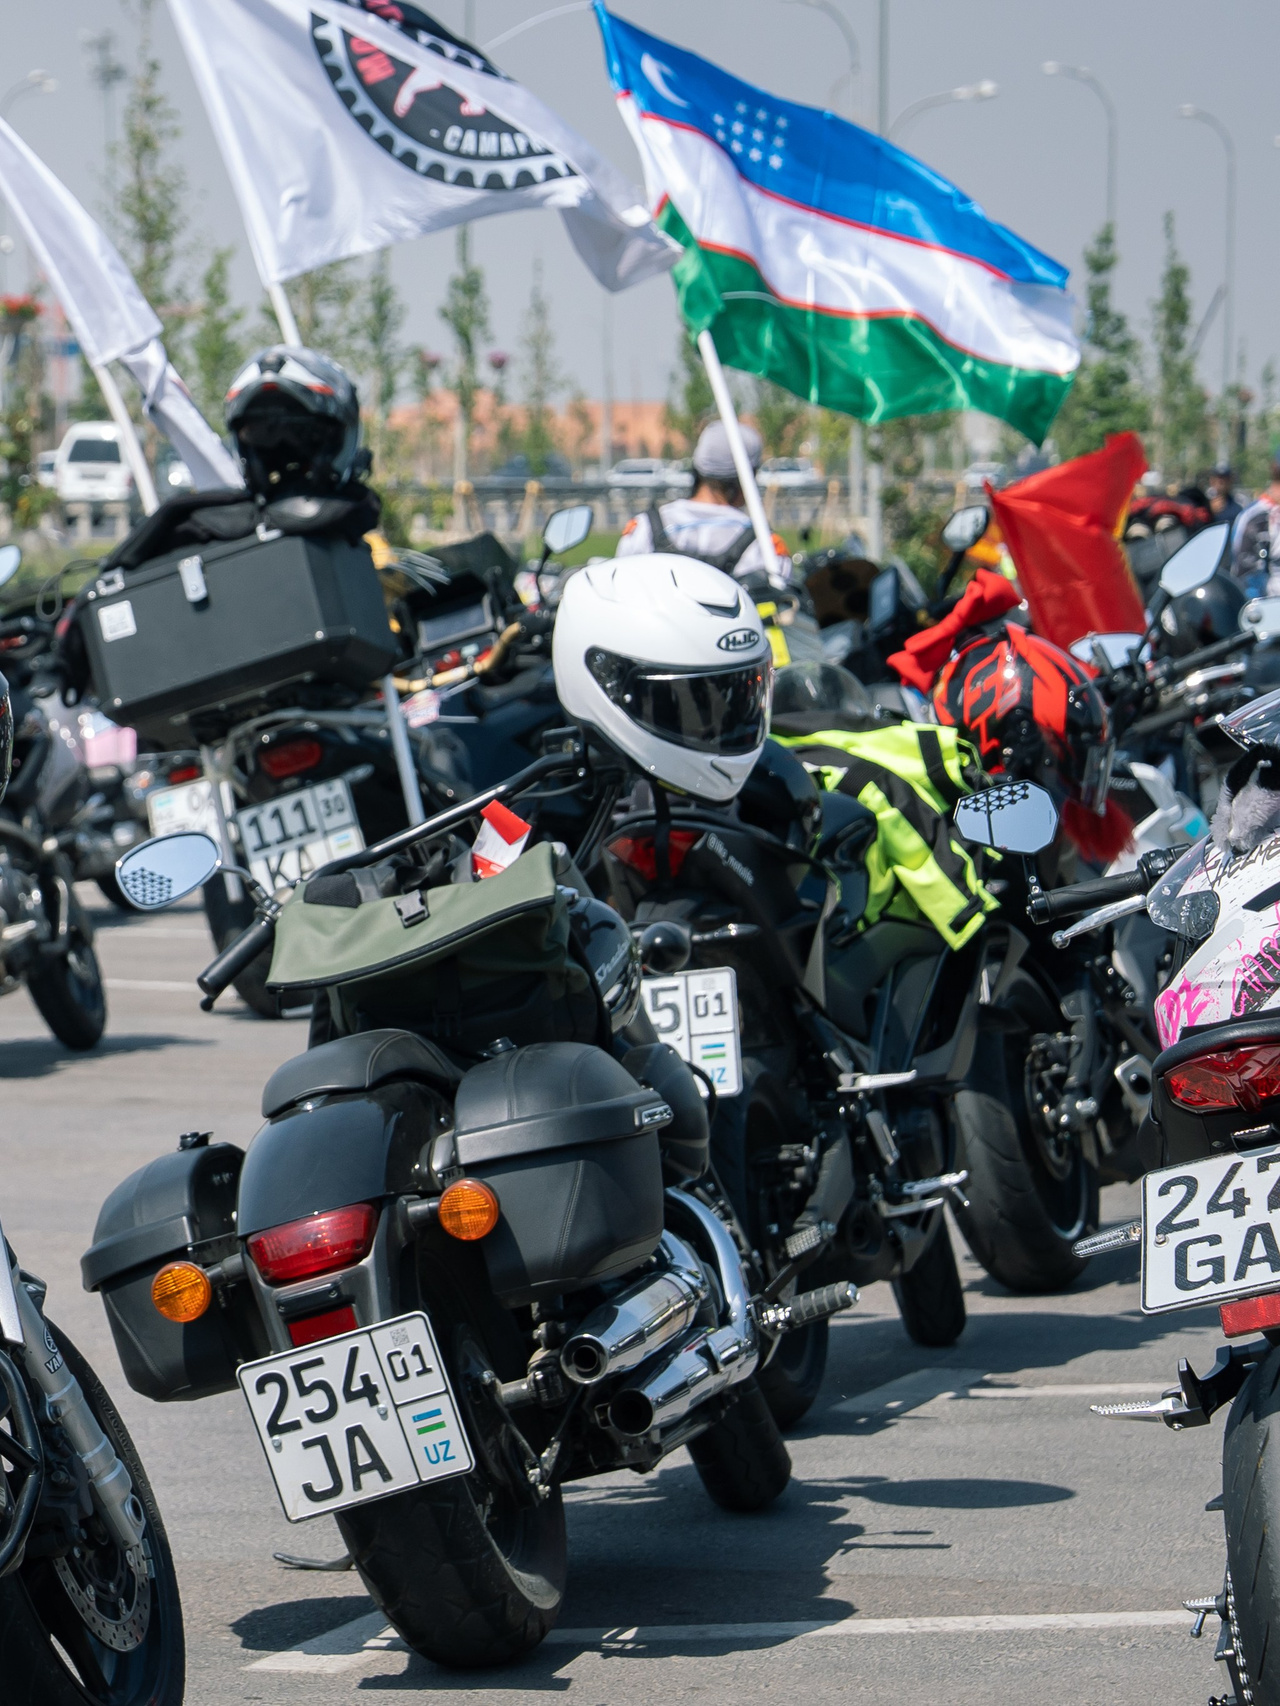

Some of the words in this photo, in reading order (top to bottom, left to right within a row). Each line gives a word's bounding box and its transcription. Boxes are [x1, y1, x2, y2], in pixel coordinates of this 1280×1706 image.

[724, 631, 758, 649] HJC
[247, 798, 316, 852] 111
[694, 990, 728, 1018] 01
[1174, 1222, 1280, 1292] GA
[254, 1345, 380, 1438] 254
[386, 1343, 433, 1382] 01
[301, 1424, 394, 1502] JA
[423, 1439, 456, 1465] UZ
